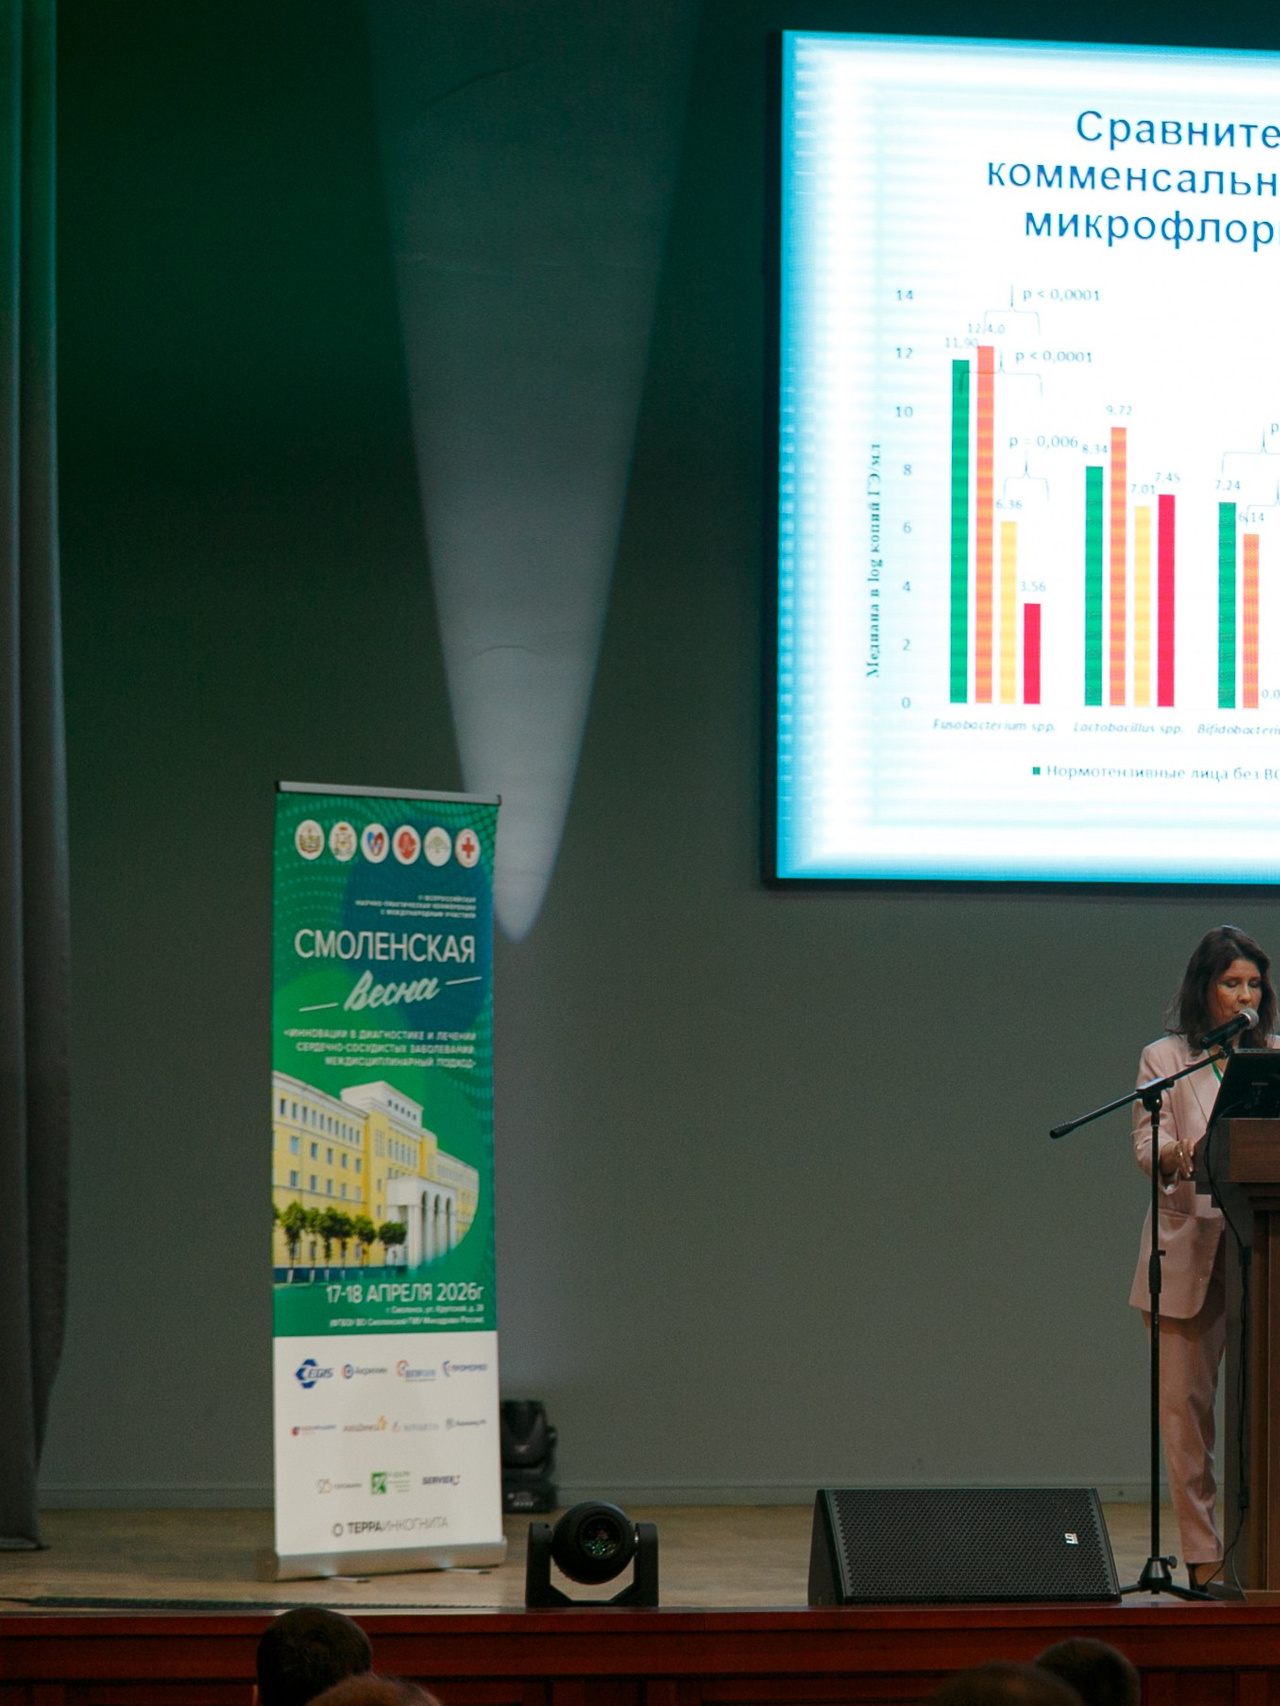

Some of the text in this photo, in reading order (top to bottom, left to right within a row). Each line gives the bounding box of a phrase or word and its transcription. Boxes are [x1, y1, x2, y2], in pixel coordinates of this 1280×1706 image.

[895, 289, 914, 301] 14
[1022, 288, 1100, 301] p 0,0001
[895, 347, 913, 359] 12
[1015, 350, 1092, 364] p 0,0001
[895, 406, 914, 418] 10
[1270, 421, 1279, 435] p
[1009, 434, 1078, 449] p 0,006
[903, 463, 912, 476] 8
[868, 501, 881, 553] копий
[902, 521, 912, 533] 6
[867, 558, 882, 583] log
[902, 581, 911, 592] 4
[866, 602, 880, 678] Медиана
[902, 639, 911, 651] 2
[901, 697, 911, 708] 0
[932, 718, 1055, 734] Fusobacterium spp.
[1073, 721, 1184, 735] Lactobacillus spp.
[1046, 765, 1186, 780] Нормотензивные
[1191, 769, 1228, 781] лица
[1233, 767, 1260, 780] без
[294, 928, 476, 963] СМОЛЕНСКАЯ
[343, 969, 441, 1012] Весна
[359, 1030, 424, 1041] ДИАГНОСТИКЕ
[435, 1032, 476, 1041] ЛЕЧЕНИИ
[296, 1042, 407, 1053] СЕРДЕЧНО-СОСУДИСТЫХ
[325, 1281, 484, 1304] 17-18 АПРЕЛЯ 2026г
[308, 1367, 335, 1379] EGIS
[347, 1516, 449, 1534] ТЕРРАИНКОГНИТА
